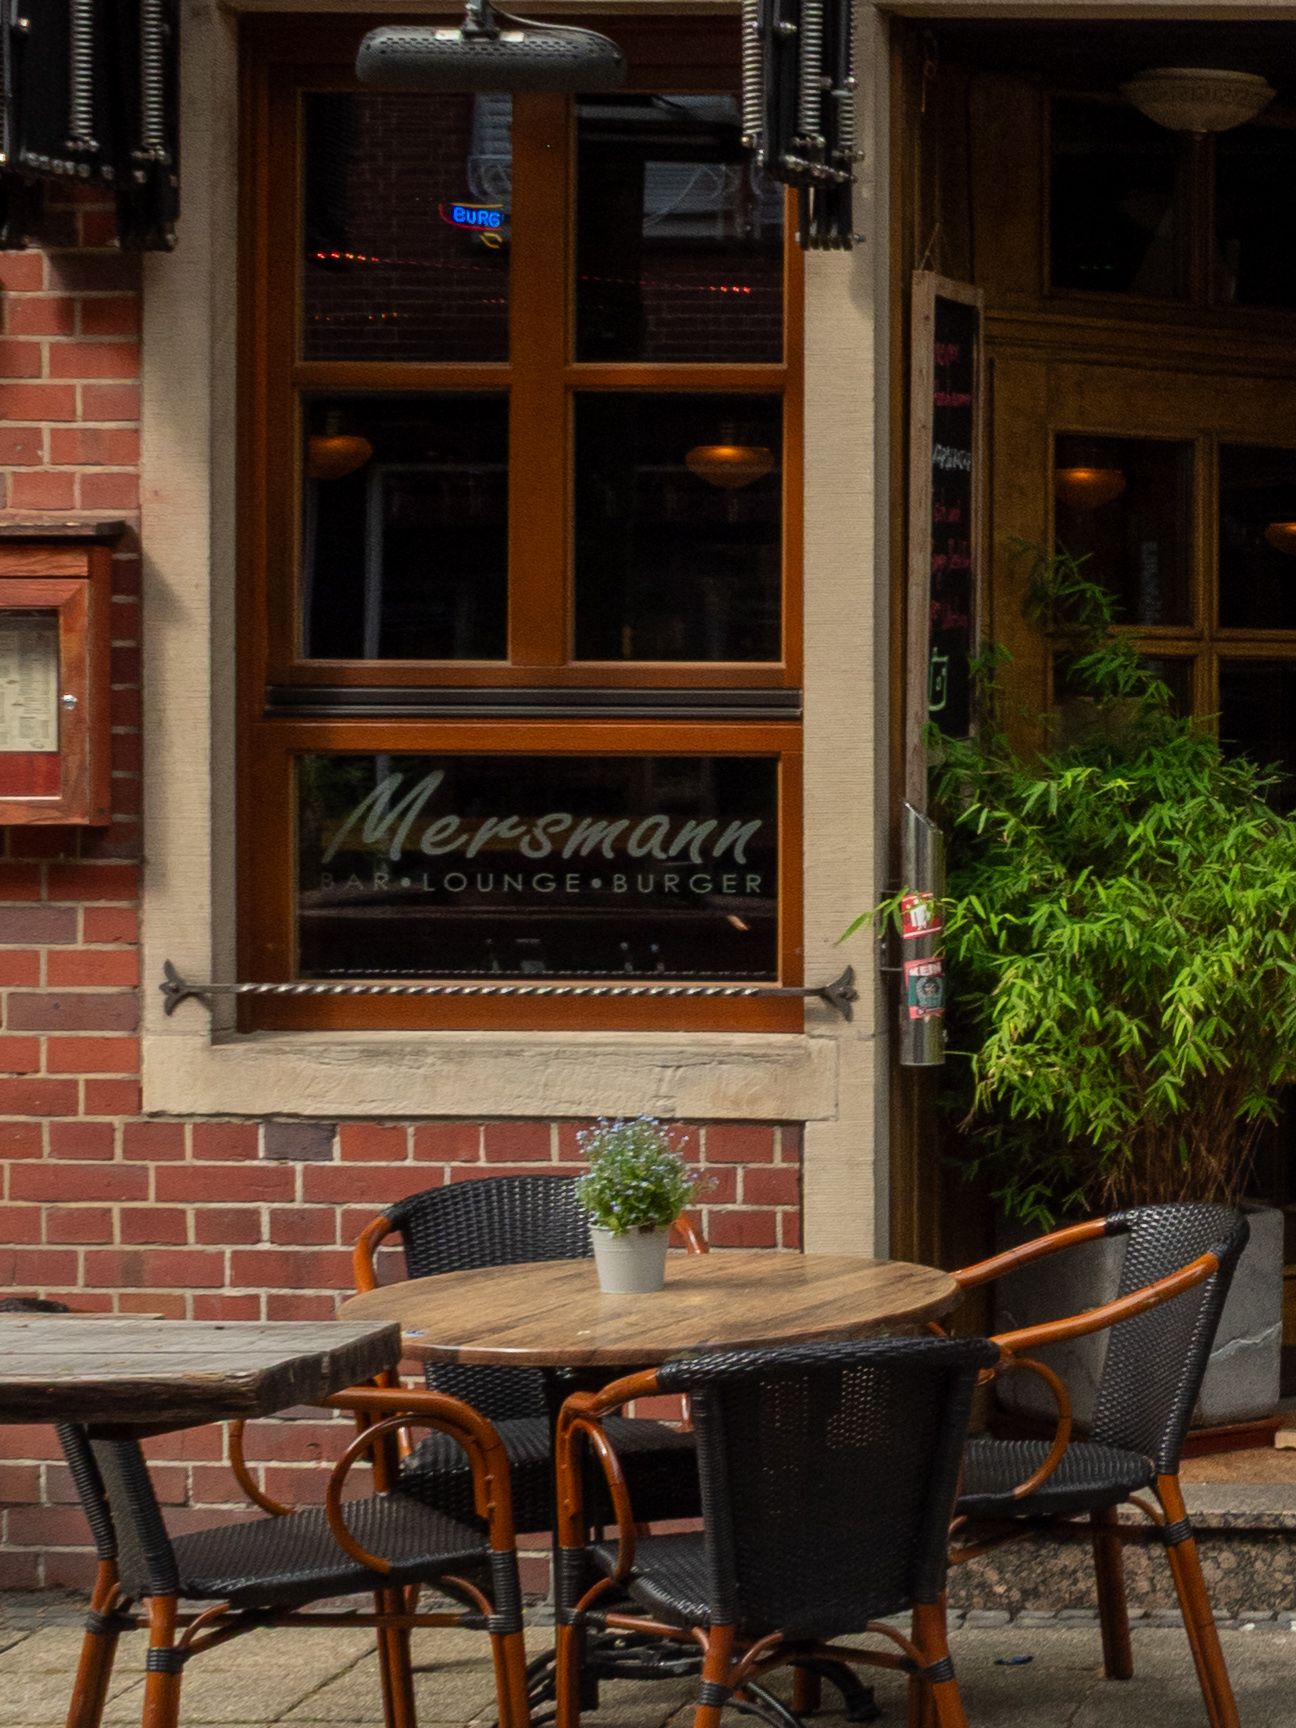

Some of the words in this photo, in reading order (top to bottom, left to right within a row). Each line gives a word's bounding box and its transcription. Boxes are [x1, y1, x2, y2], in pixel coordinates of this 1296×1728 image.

[452, 205, 505, 228] BURG
[321, 770, 763, 865] Mersmann
[321, 872, 389, 891] BAR
[422, 872, 581, 893] LOUNGE
[612, 873, 762, 894] BURGER
